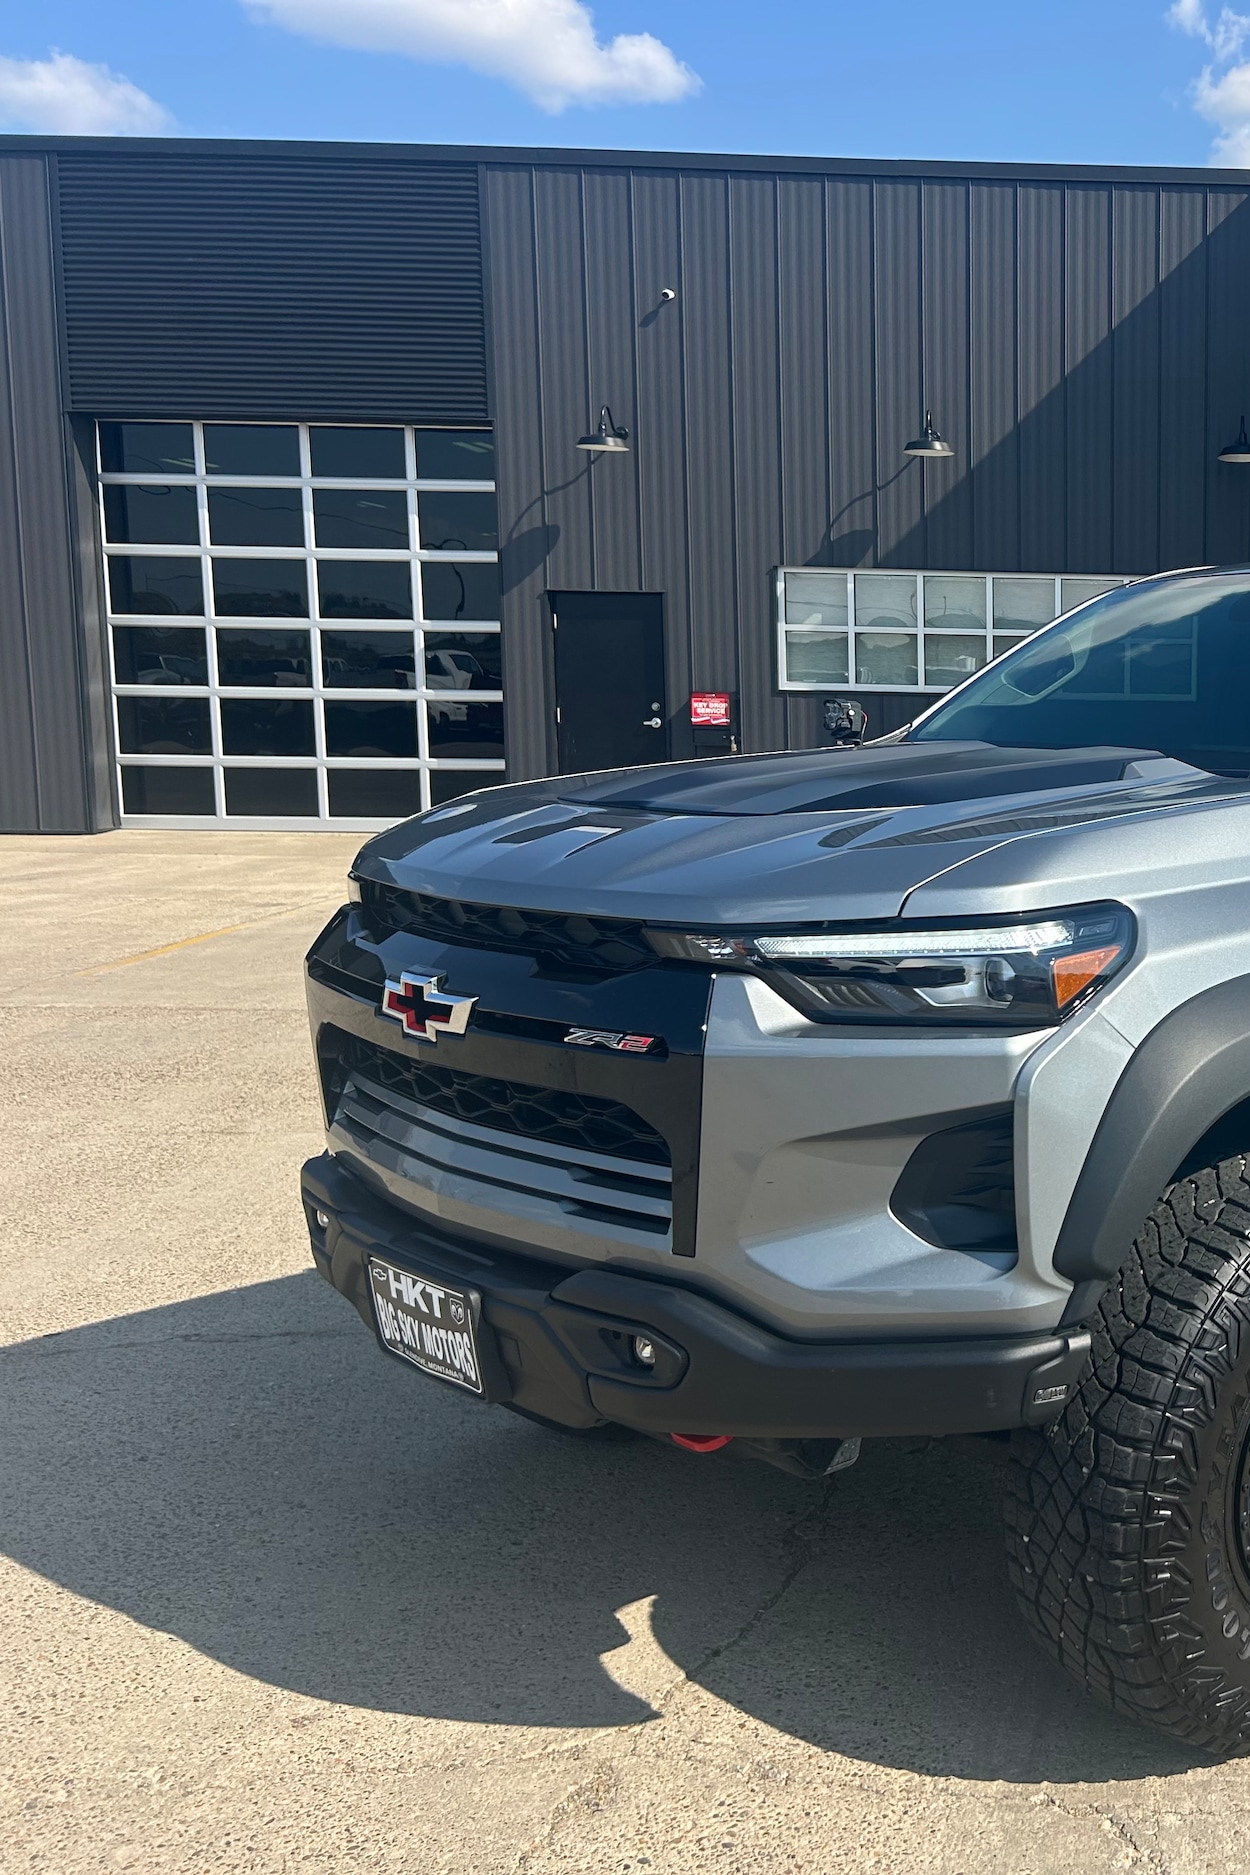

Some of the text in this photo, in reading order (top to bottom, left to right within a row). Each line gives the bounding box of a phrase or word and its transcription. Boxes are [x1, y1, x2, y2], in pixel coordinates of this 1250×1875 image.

[563, 1027, 655, 1053] ZR2
[387, 1268, 445, 1318] HKT
[376, 1292, 476, 1381] BIG SKY MOTORS
